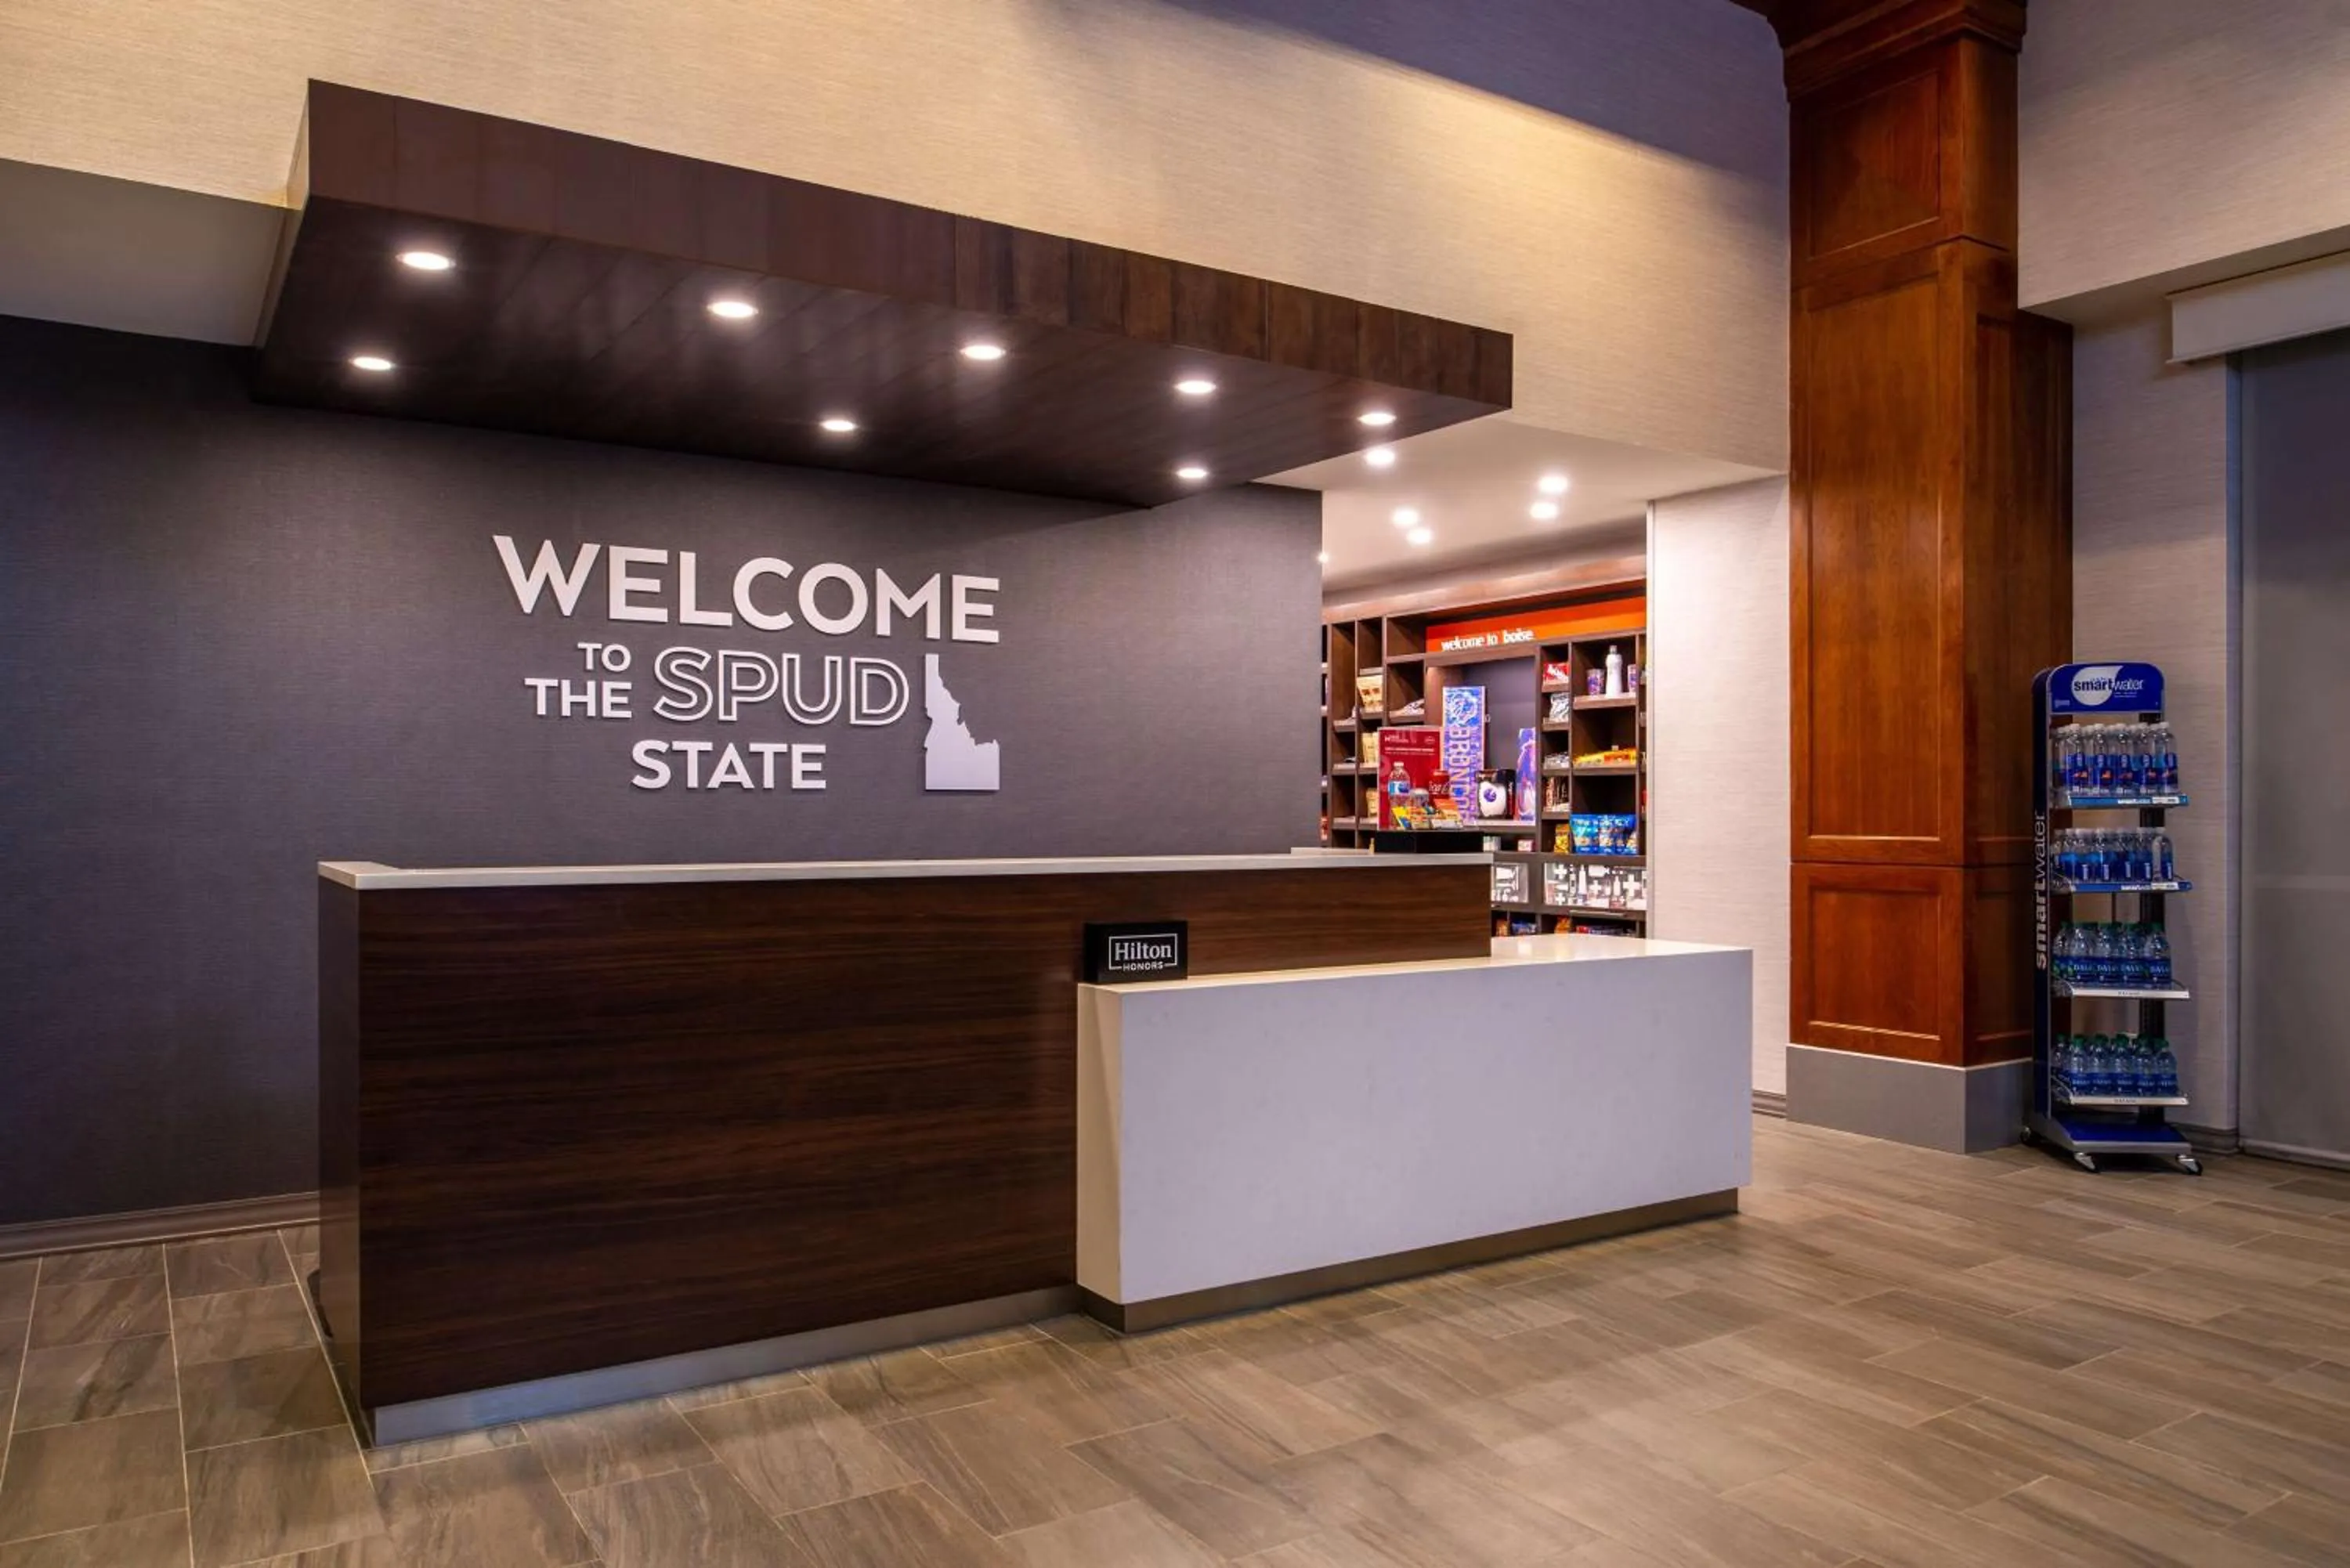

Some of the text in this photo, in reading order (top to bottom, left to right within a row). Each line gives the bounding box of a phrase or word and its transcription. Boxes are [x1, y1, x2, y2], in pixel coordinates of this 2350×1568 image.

[492, 535, 1000, 643] WELCOME
[577, 641, 631, 672] TO
[1441, 635, 1485, 652] welcome
[1487, 632, 1498, 646] to
[524, 677, 632, 718] THE
[653, 646, 909, 725] SPUD
[2073, 677, 2144, 692] smartwater
[630, 739, 826, 789] STATE
[2034, 810, 2047, 970] smartwater
[1115, 941, 1172, 961] Hilton
[1123, 961, 1163, 971] HONORS
